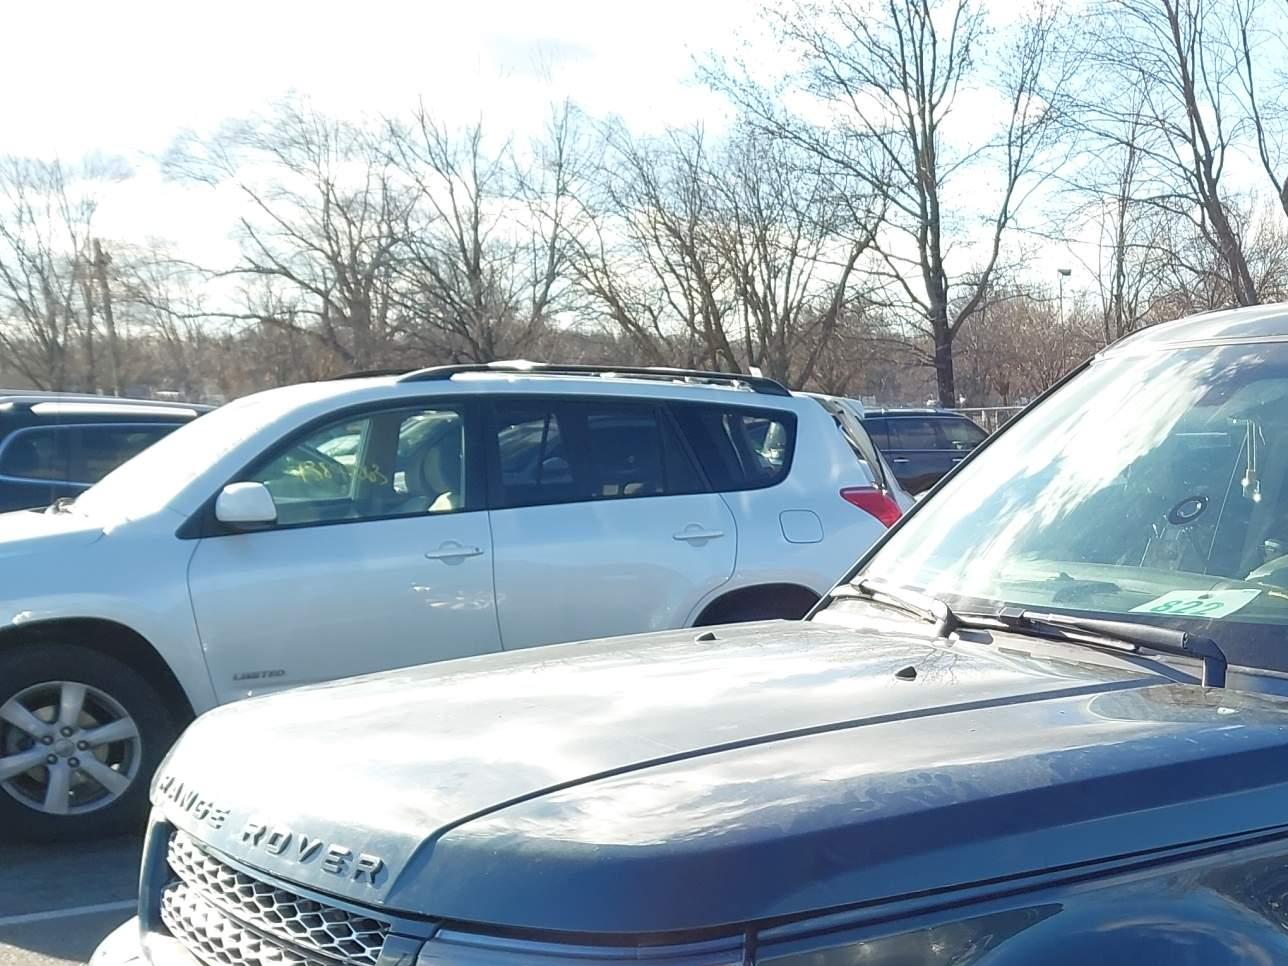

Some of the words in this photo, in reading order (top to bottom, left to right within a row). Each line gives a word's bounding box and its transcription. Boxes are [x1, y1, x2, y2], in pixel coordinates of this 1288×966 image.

[1150, 600, 1225, 616] 822
[159, 775, 231, 830] RANGE
[241, 822, 386, 887] ROVER
